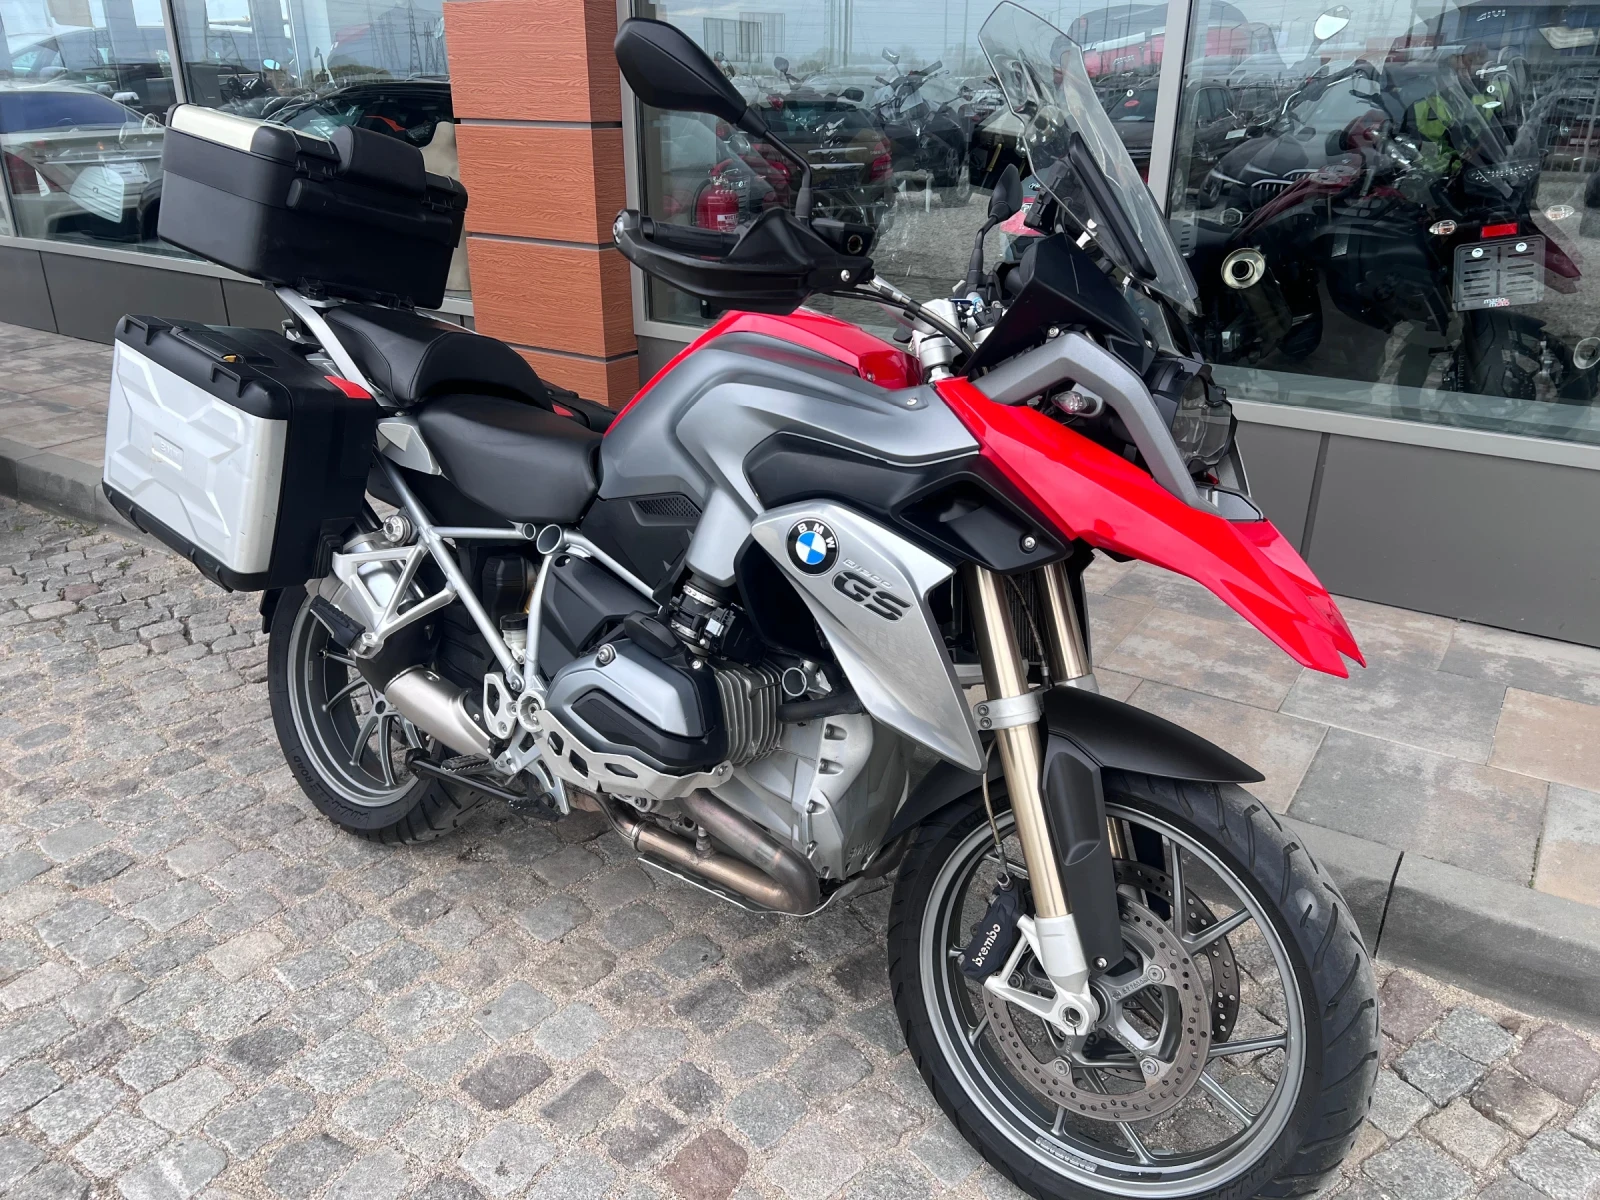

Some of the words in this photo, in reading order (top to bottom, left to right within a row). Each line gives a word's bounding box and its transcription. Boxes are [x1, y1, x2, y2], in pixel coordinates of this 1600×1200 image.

[797, 523, 836, 549] BMW
[832, 571, 912, 621] GS
[293, 755, 313, 783] ROAD
[972, 923, 1001, 968] brembo
